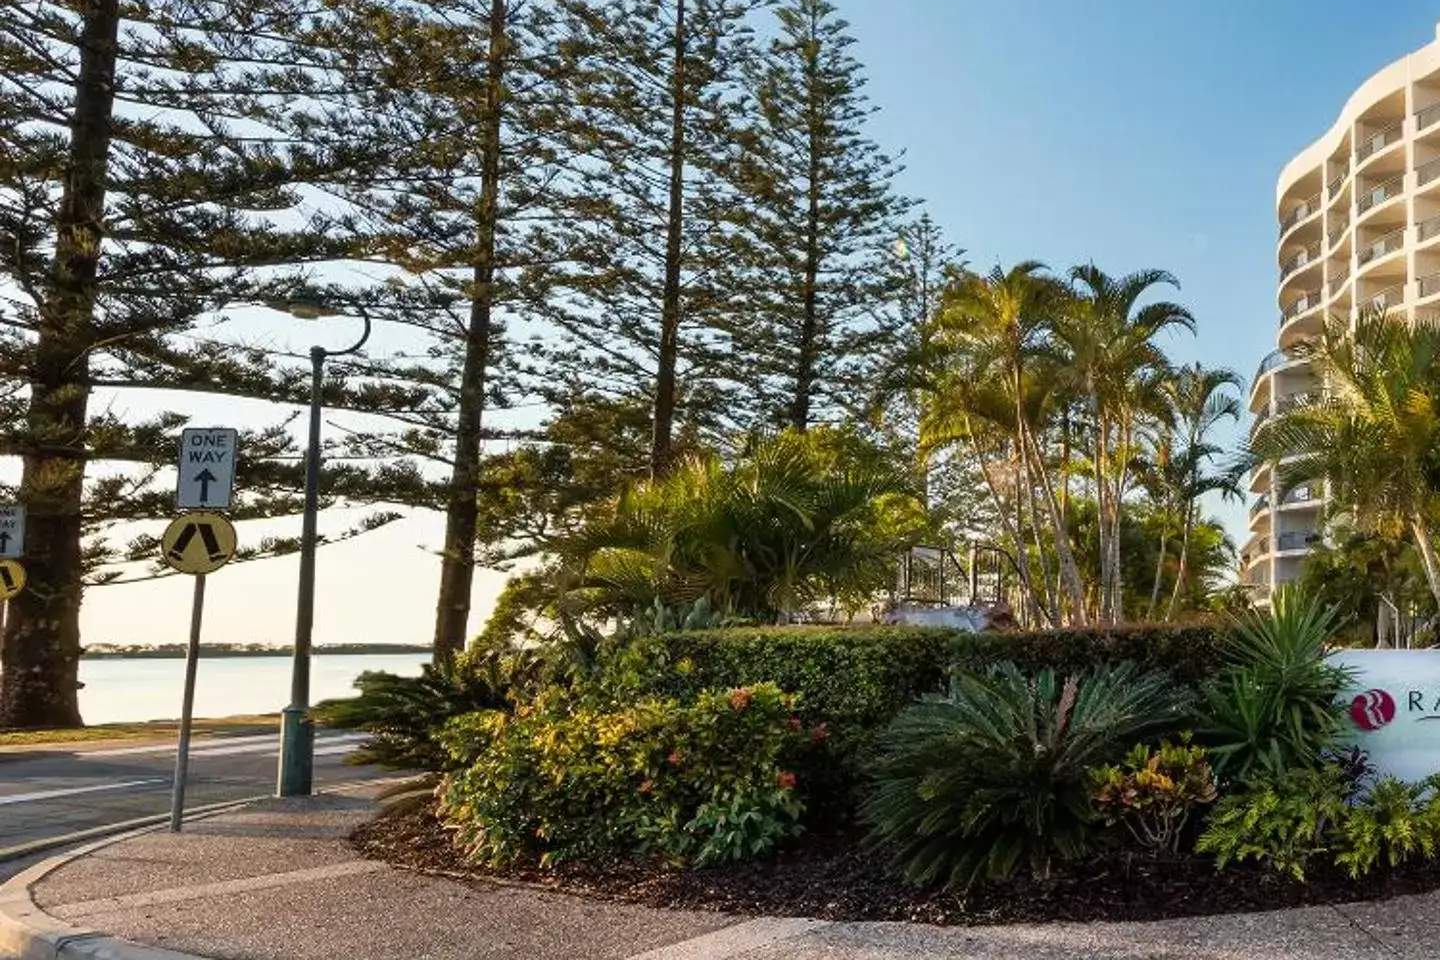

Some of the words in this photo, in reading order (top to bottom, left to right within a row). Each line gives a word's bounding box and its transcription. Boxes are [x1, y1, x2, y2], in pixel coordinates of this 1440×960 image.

[191, 434, 227, 447] ONE
[188, 451, 226, 464] WAY
[0, 519, 16, 529] AY
